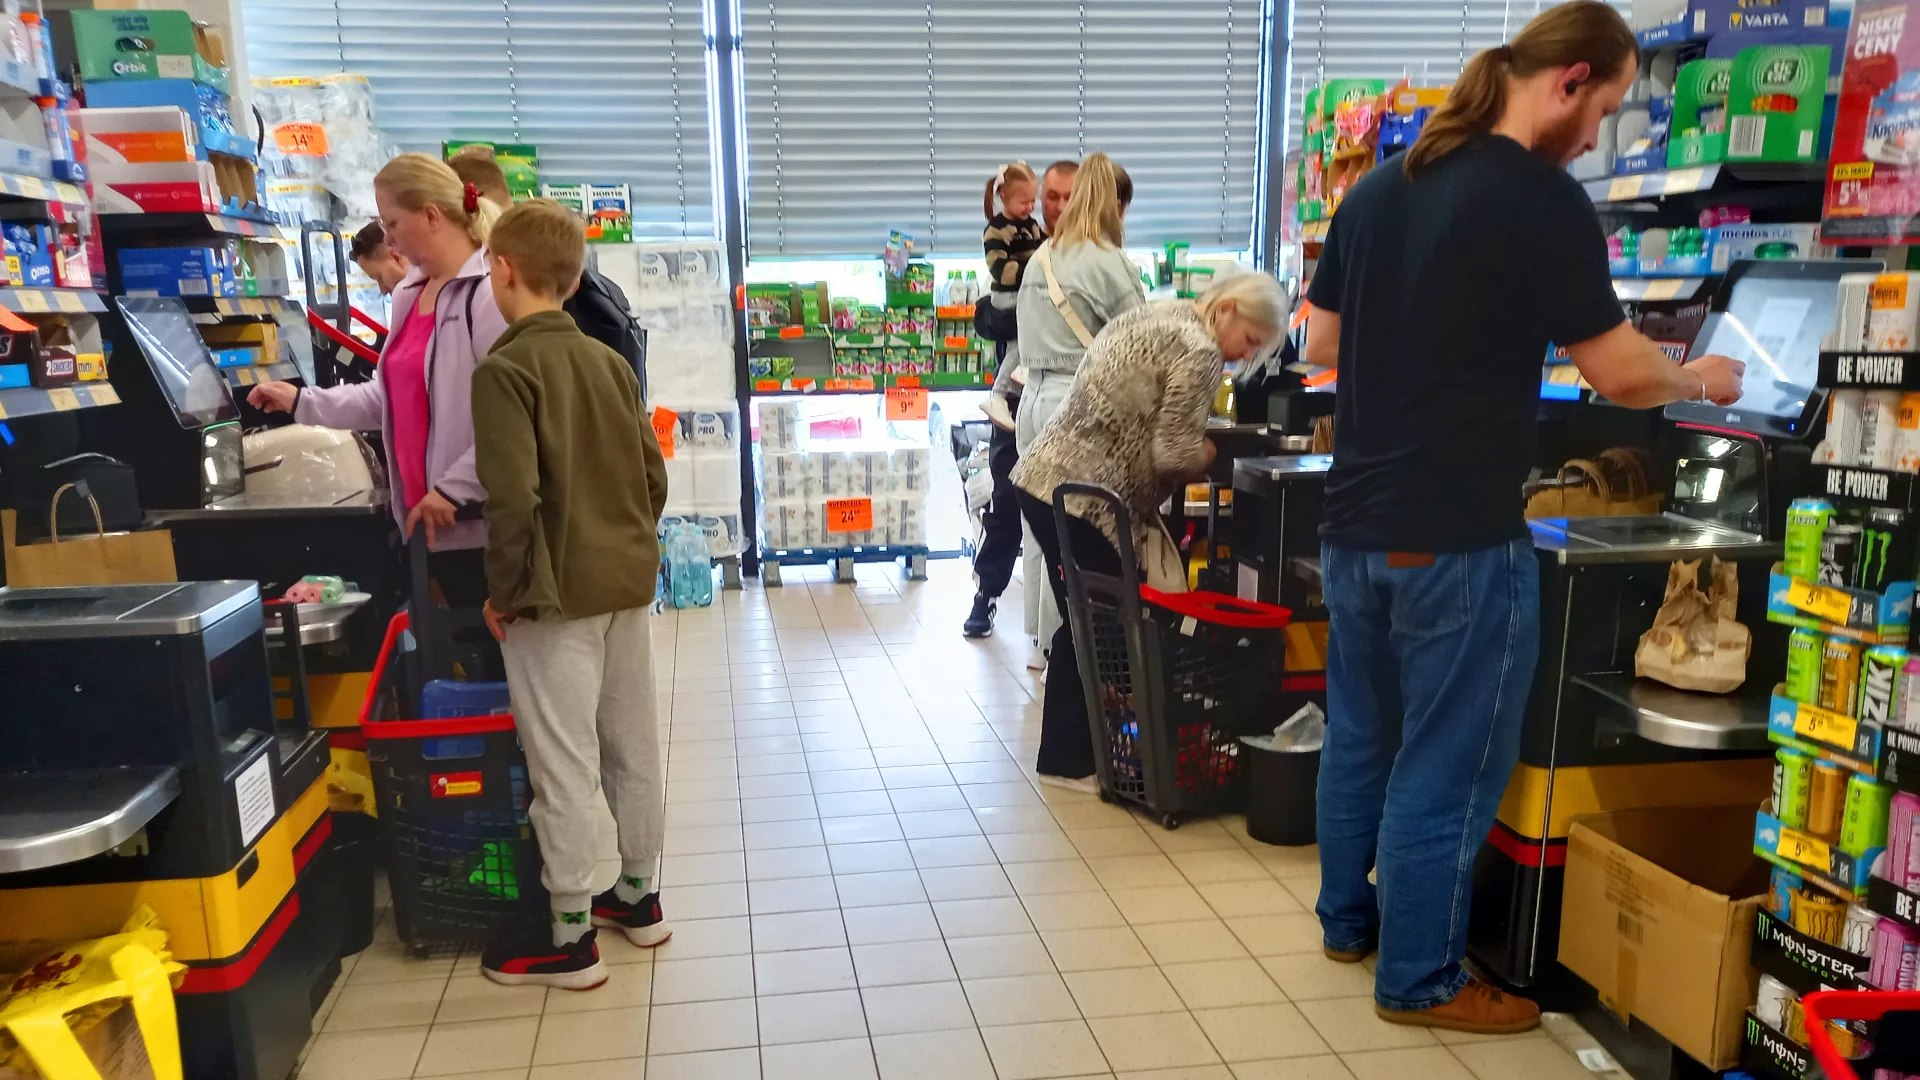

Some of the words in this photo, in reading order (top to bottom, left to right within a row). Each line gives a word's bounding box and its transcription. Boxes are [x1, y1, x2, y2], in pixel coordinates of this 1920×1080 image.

[1745, 13, 1789, 27] VARTA
[1650, 30, 1669, 40] VARTA
[1854, 35, 1901, 60] CENY
[111, 60, 148, 75] Orbit
[1721, 228, 1769, 239] mentos
[31, 265, 51, 281] OREO
[642, 266, 658, 276] PRO
[682, 264, 698, 274] PRO
[46, 360, 52, 377] 2
[1837, 355, 1854, 383] BE
[1855, 355, 1904, 385] POWER
[697, 426, 715, 435] PRO
[1826, 468, 1843, 496] BE
[1844, 470, 1889, 501] POWER
[1863, 658, 1894, 724] ZIK
[1895, 891, 1913, 920] BE
[1773, 927, 1855, 980] MONSTER
[1784, 951, 1839, 983] ENERGY
[1763, 1034, 1808, 1073] MONS
